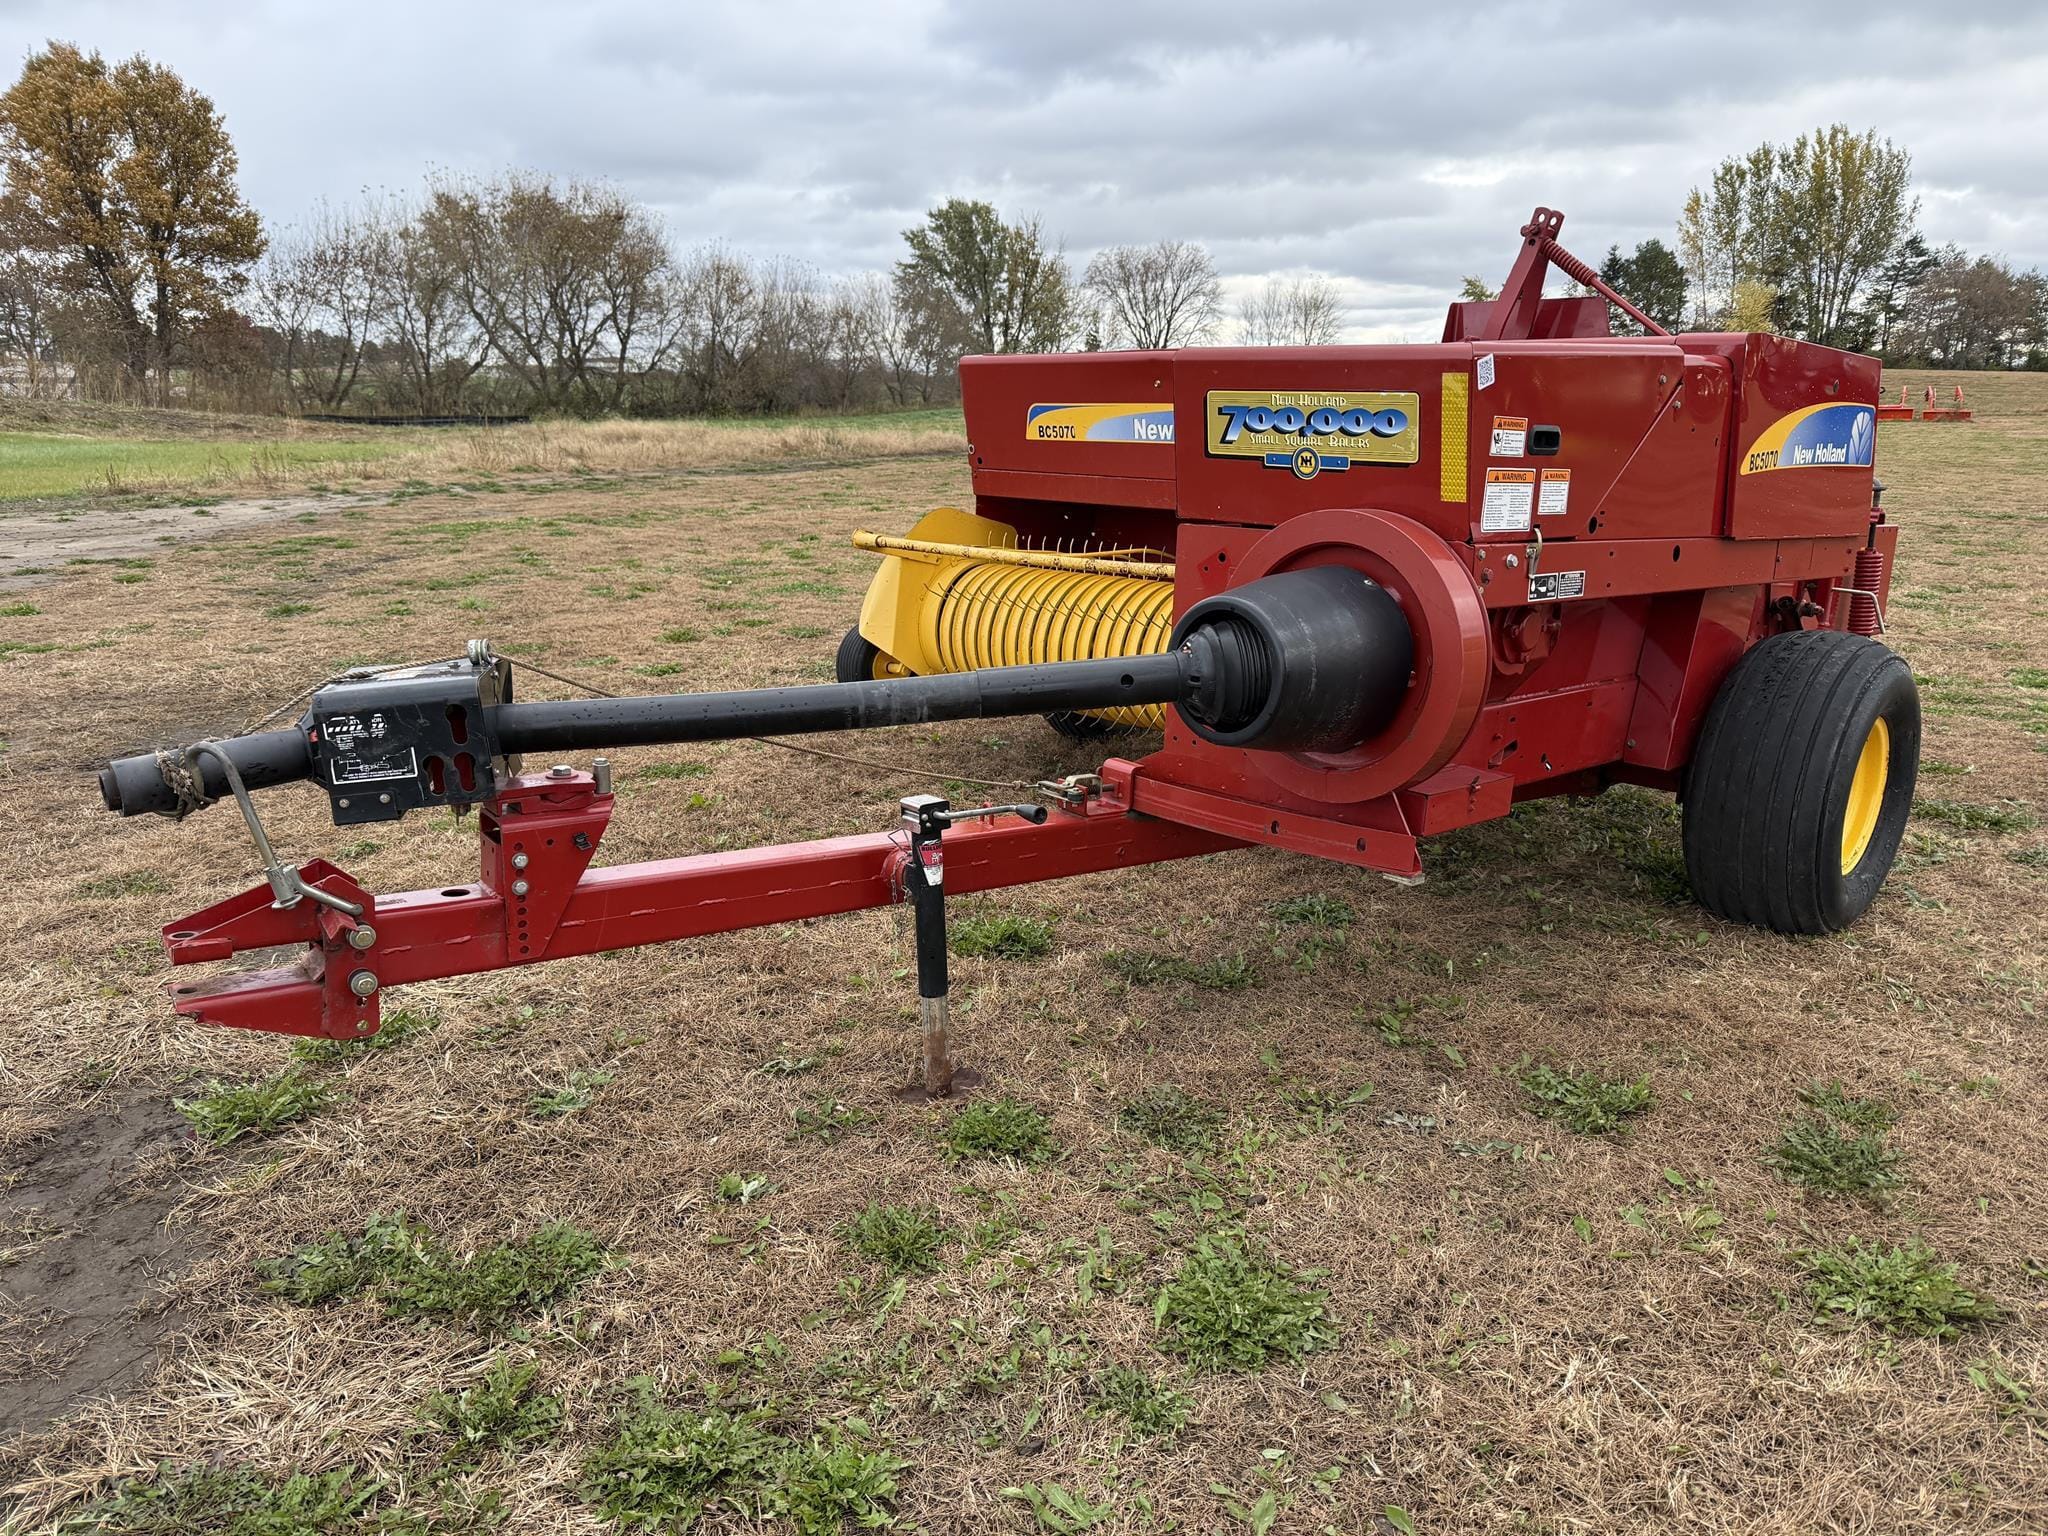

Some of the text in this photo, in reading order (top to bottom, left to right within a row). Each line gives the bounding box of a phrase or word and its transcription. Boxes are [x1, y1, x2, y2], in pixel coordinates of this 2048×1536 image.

[1271, 393, 1347, 407] NEW HOLLAND
[1038, 418, 1174, 440] BC5070 New
[1218, 405, 1408, 443] 700,000
[1249, 433, 1370, 448] SMALL SQUARE BALERS
[1749, 442, 1848, 472] BC5070 New Holland
[1502, 473, 1527, 481] WARNING
